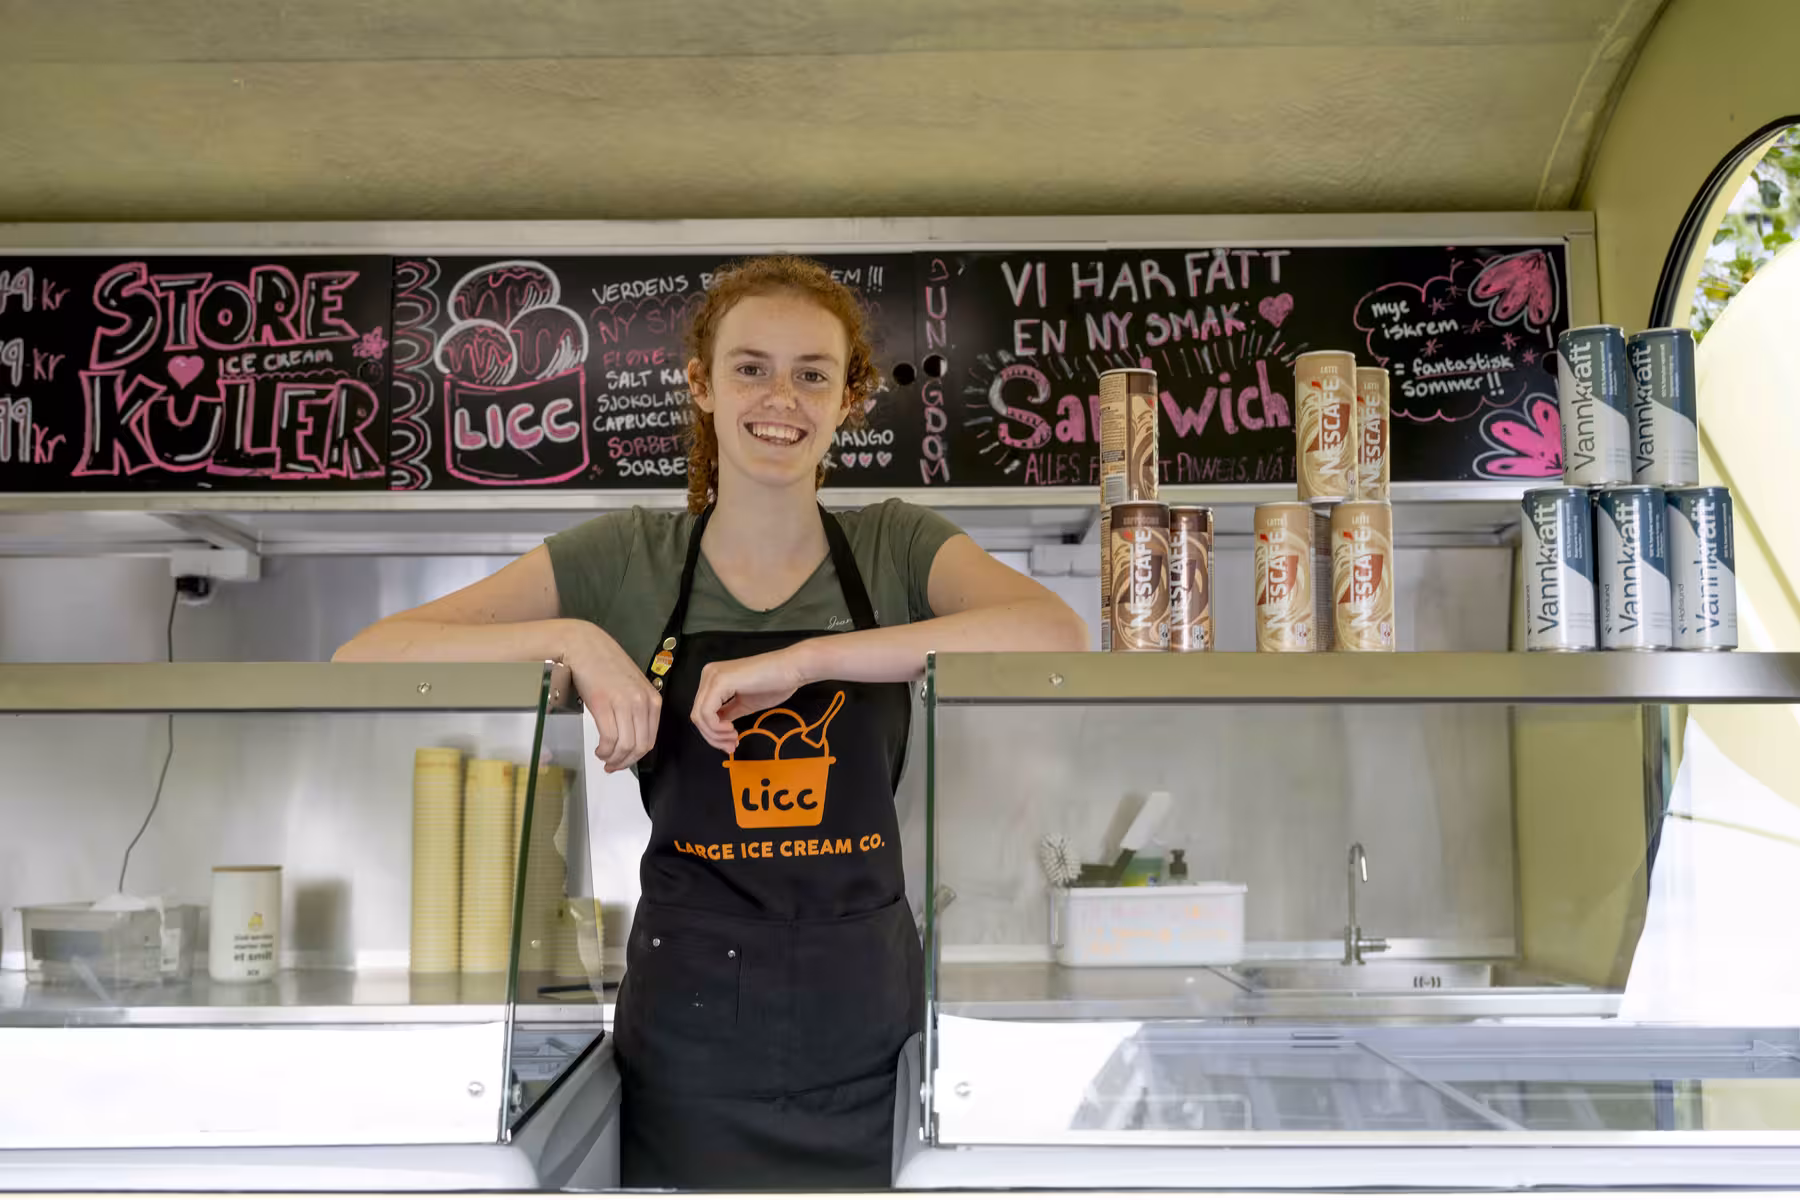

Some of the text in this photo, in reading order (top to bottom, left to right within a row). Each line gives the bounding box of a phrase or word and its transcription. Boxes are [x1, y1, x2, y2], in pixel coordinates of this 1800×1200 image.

[592, 275, 689, 305] VERDENS
[1000, 247, 1291, 308] VI HAR FÅTT
[90, 262, 359, 370] STORE
[597, 312, 637, 345] NY
[1014, 318, 1067, 356] EN
[1085, 311, 1132, 350] NY
[1371, 299, 1410, 323] mye
[1382, 318, 1459, 340] iskrem
[0, 337, 25, 388] 9
[218, 349, 333, 375] ICE CREAM
[605, 370, 652, 390] SALT
[1412, 353, 1515, 377] fantastisk
[71, 370, 385, 480] KULER
[455, 398, 580, 450] LICC
[988, 359, 1290, 449] Sawich
[1568, 340, 1596, 471] Vannkraft
[1632, 344, 1655, 473] Vannkraft
[616, 457, 689, 477] SORBE
[1024, 452, 1081, 485] ALLES
[1533, 502, 1559, 634] Vannkraft
[1615, 500, 1642, 633] Vannkraft
[674, 833, 885, 861] LARGE ICE CREAM CO.
